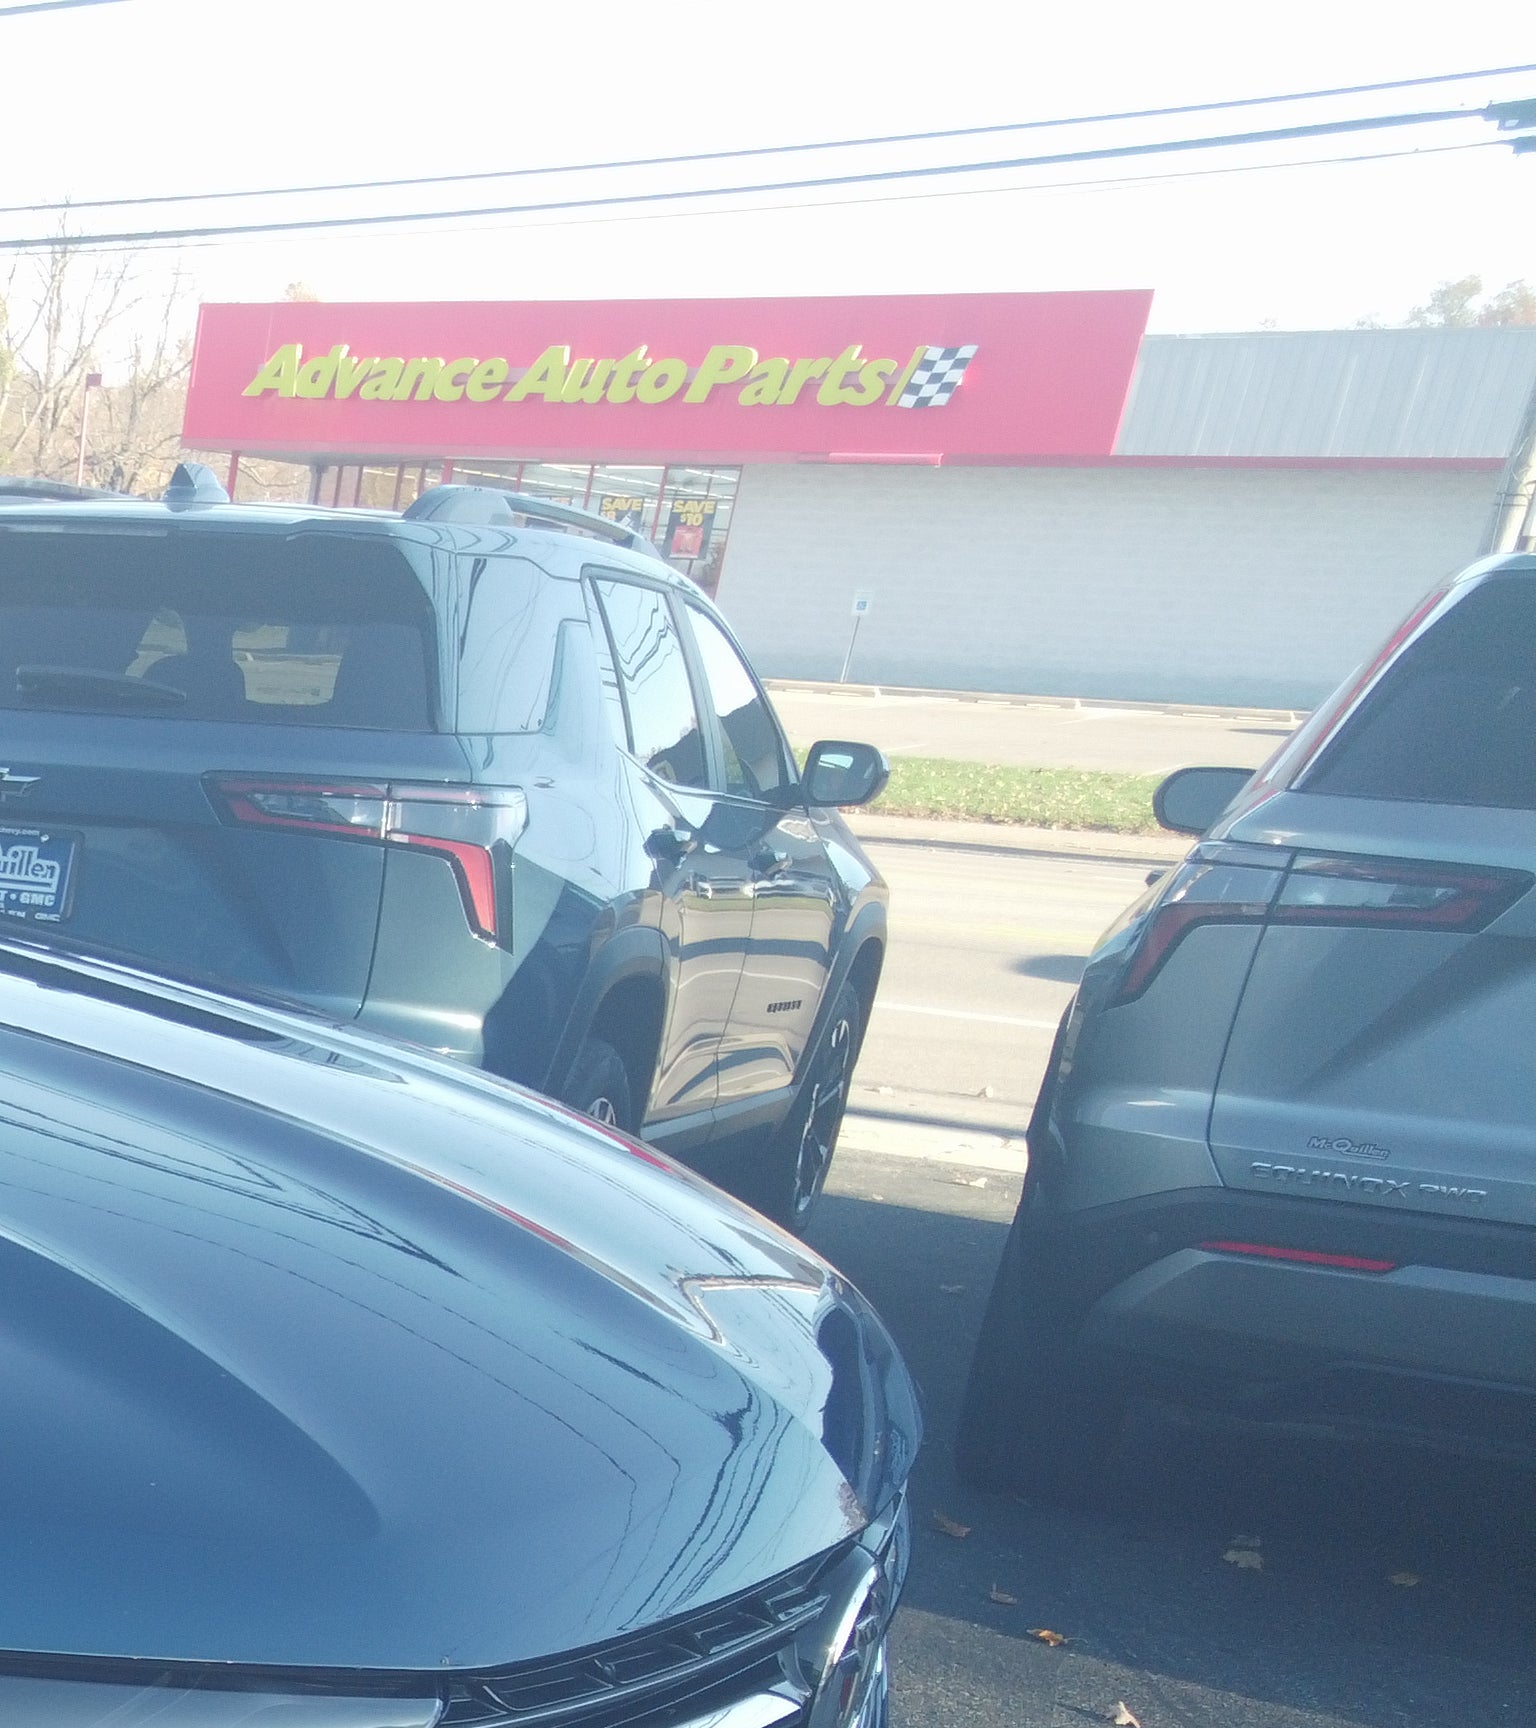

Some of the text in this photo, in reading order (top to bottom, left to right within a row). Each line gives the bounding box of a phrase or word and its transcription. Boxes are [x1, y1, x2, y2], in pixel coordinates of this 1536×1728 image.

[241, 343, 898, 406] Advance Auto Parts
[601, 498, 644, 511] SAVE
[672, 500, 716, 514] SAVE
[19, 892, 56, 907] GMC
[1251, 1161, 1411, 1199] EQUINOX
